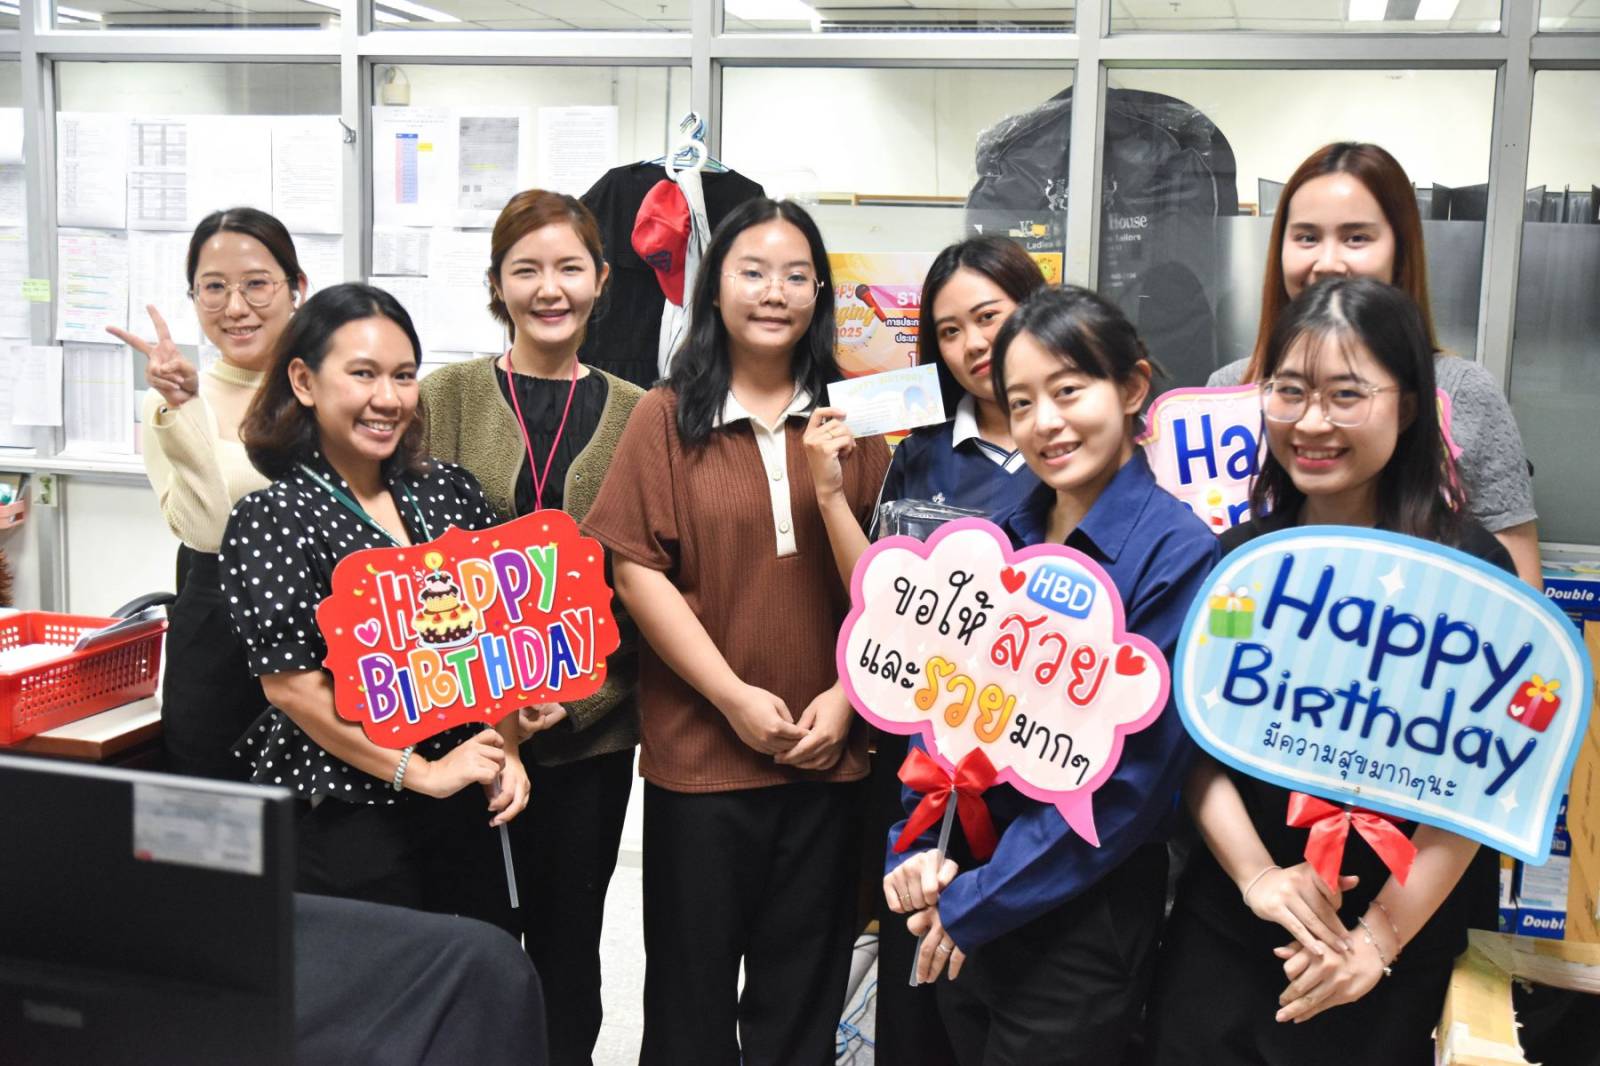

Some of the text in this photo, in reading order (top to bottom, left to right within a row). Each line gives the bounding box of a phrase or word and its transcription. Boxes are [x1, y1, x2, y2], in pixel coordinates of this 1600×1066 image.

[1109, 213, 1149, 230] House
[1032, 567, 1093, 613] HBD
[1544, 586, 1595, 601] Double
[1261, 552, 1534, 713] Happy
[357, 606, 595, 724] BIRTHDAY
